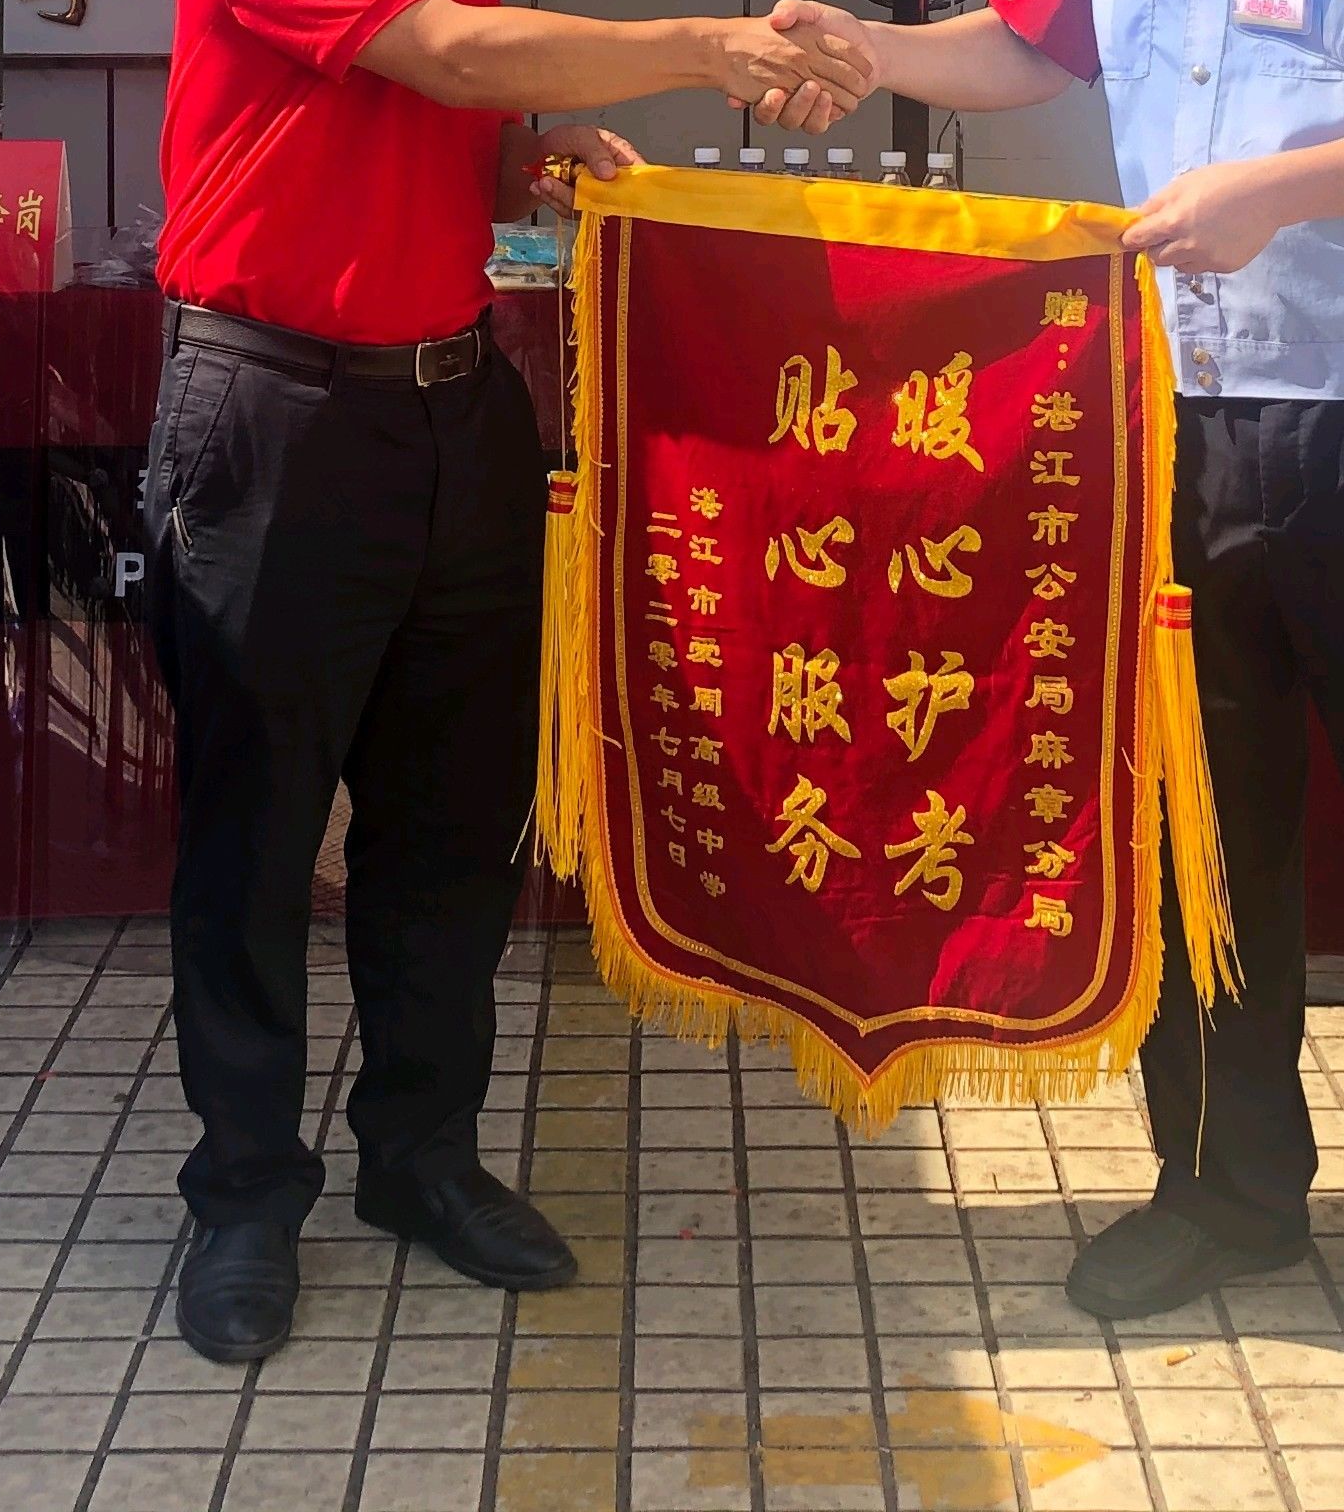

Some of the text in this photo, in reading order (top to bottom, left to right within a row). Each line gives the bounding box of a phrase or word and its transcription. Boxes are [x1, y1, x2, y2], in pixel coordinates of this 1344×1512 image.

[644, 510, 687, 869] 二零二零年七月七日
[764, 342, 863, 892] 贴心服务
[882, 350, 984, 912] 暖心护考
